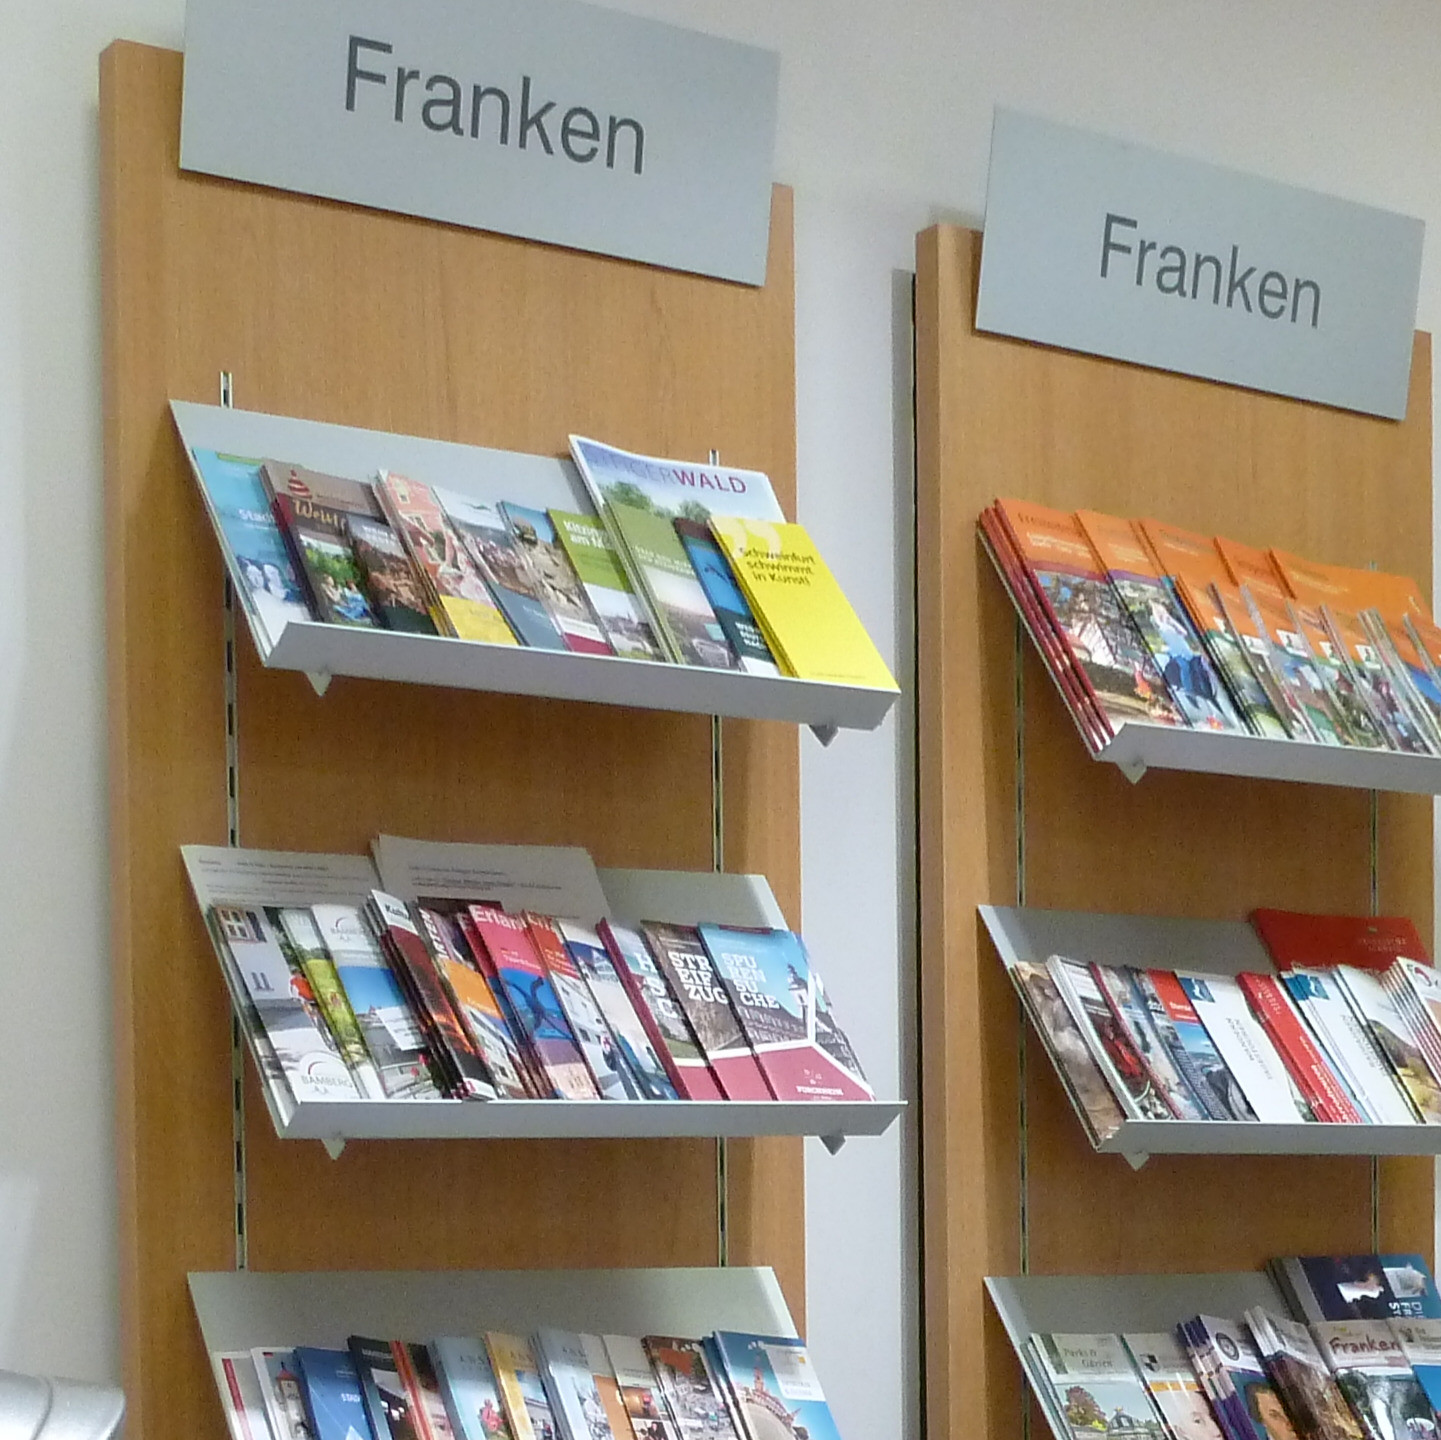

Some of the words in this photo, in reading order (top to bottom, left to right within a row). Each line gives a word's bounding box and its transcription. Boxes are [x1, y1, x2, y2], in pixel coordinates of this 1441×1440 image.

[345, 34, 645, 175] Franken
[1100, 212, 1322, 329] Franken
[684, 984, 730, 1005] ZUG
[733, 979, 759, 994] SU
[739, 992, 781, 1010] CHE
[1328, 1333, 1402, 1355] Franken
